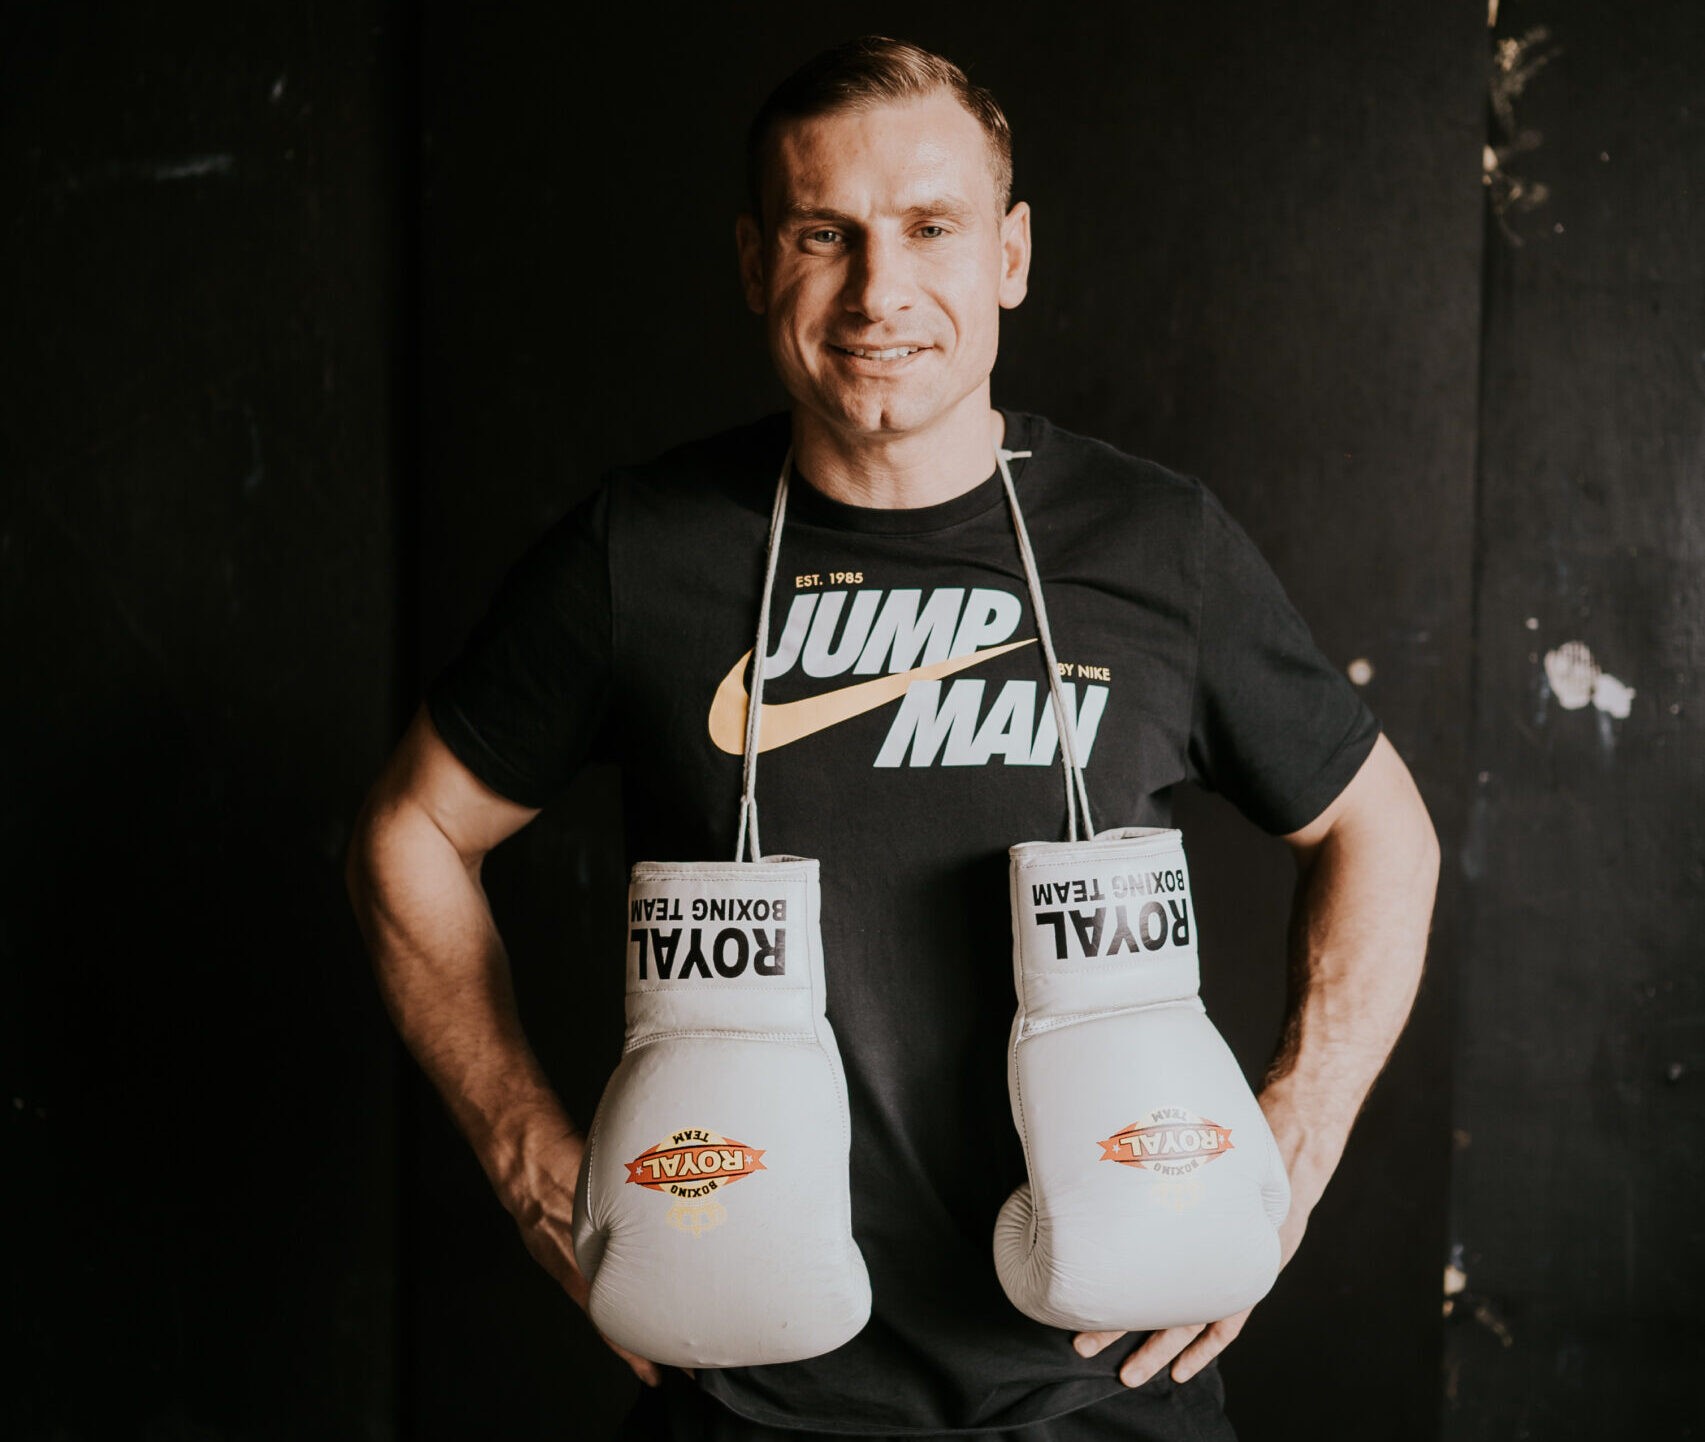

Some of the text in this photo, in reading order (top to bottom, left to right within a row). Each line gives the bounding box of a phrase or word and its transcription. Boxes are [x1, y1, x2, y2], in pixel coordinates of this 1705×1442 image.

[795, 571, 864, 589] EST. 1985
[764, 587, 1022, 680] JUMP
[1077, 664, 1111, 682] NIKE
[873, 679, 1109, 769] MAN
[1032, 870, 1185, 906] BOXING TEAM
[631, 898, 787, 923] BOXING TEAM
[1035, 898, 1189, 960] ROYAL
[631, 927, 786, 980] ROYAL
[1151, 1109, 1187, 1123] TEAM
[673, 1130, 709, 1145] TEAM
[1119, 1129, 1219, 1157] ROYAL
[642, 1149, 745, 1179] ROYAL
